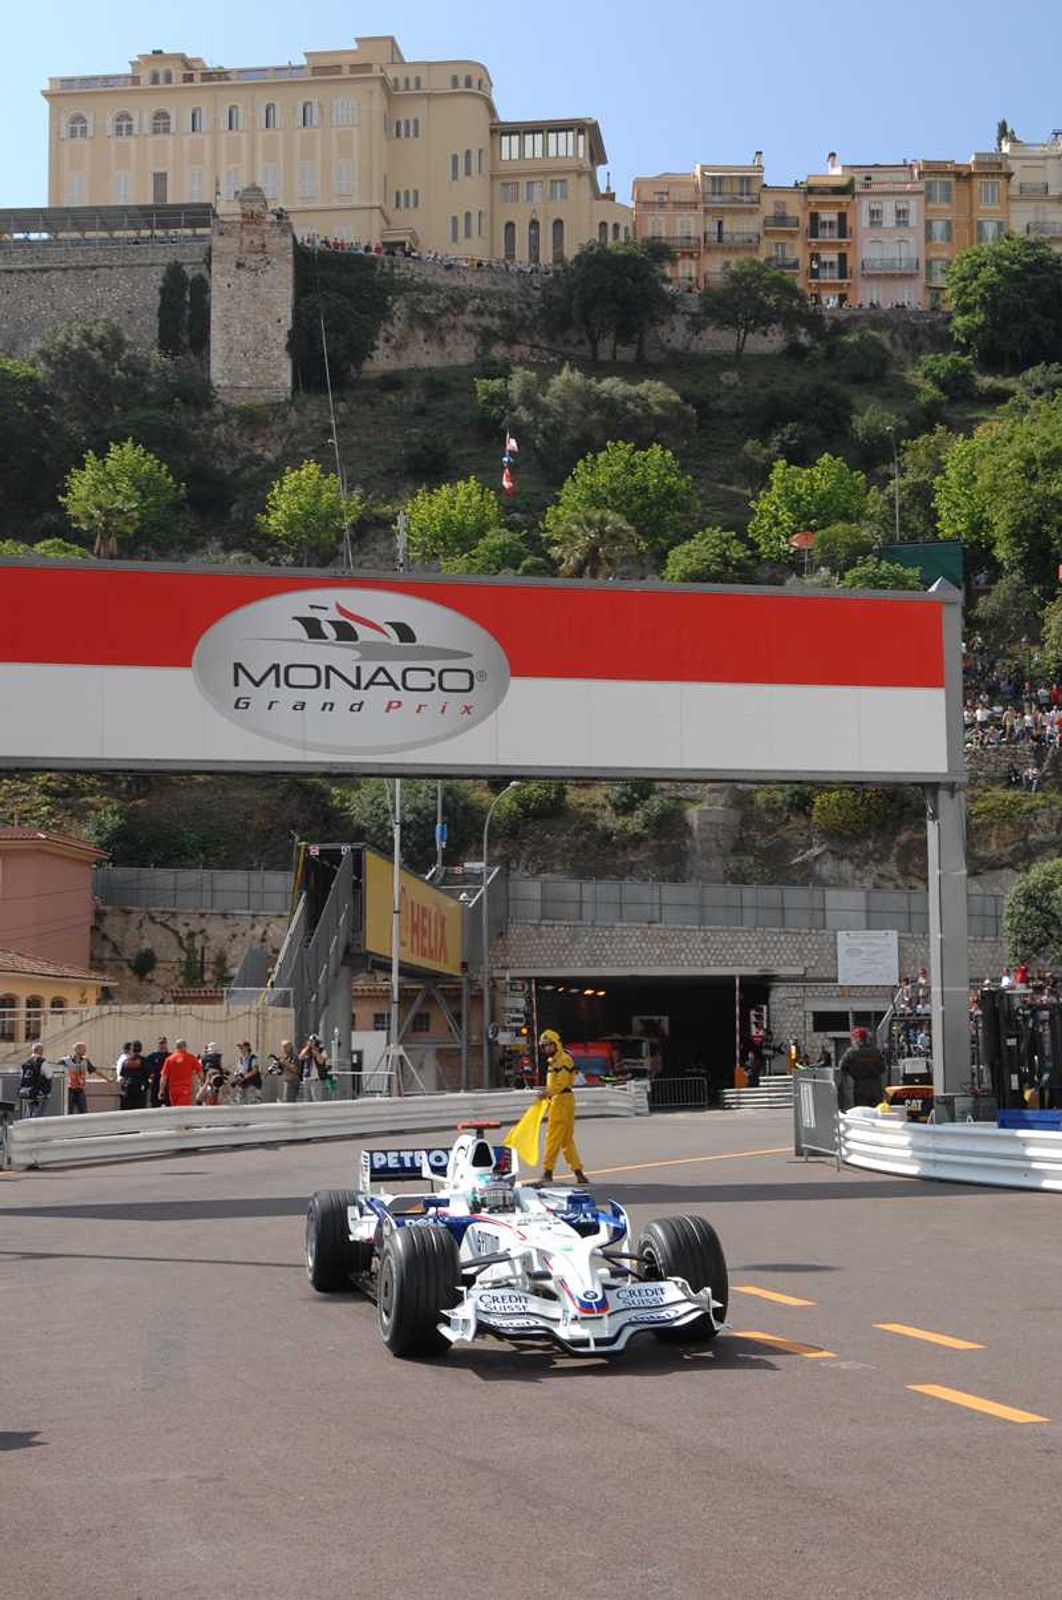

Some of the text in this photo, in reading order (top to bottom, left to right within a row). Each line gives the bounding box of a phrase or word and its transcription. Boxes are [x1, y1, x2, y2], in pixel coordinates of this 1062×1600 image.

[233, 662, 475, 693] MONACO
[234, 697, 475, 715] Grand Prix
[411, 901, 448, 965] HELIX
[905, 1099, 923, 1110] CAT
[480, 1294, 530, 1305] CREDIT
[616, 1287, 665, 1299] CREDIT
